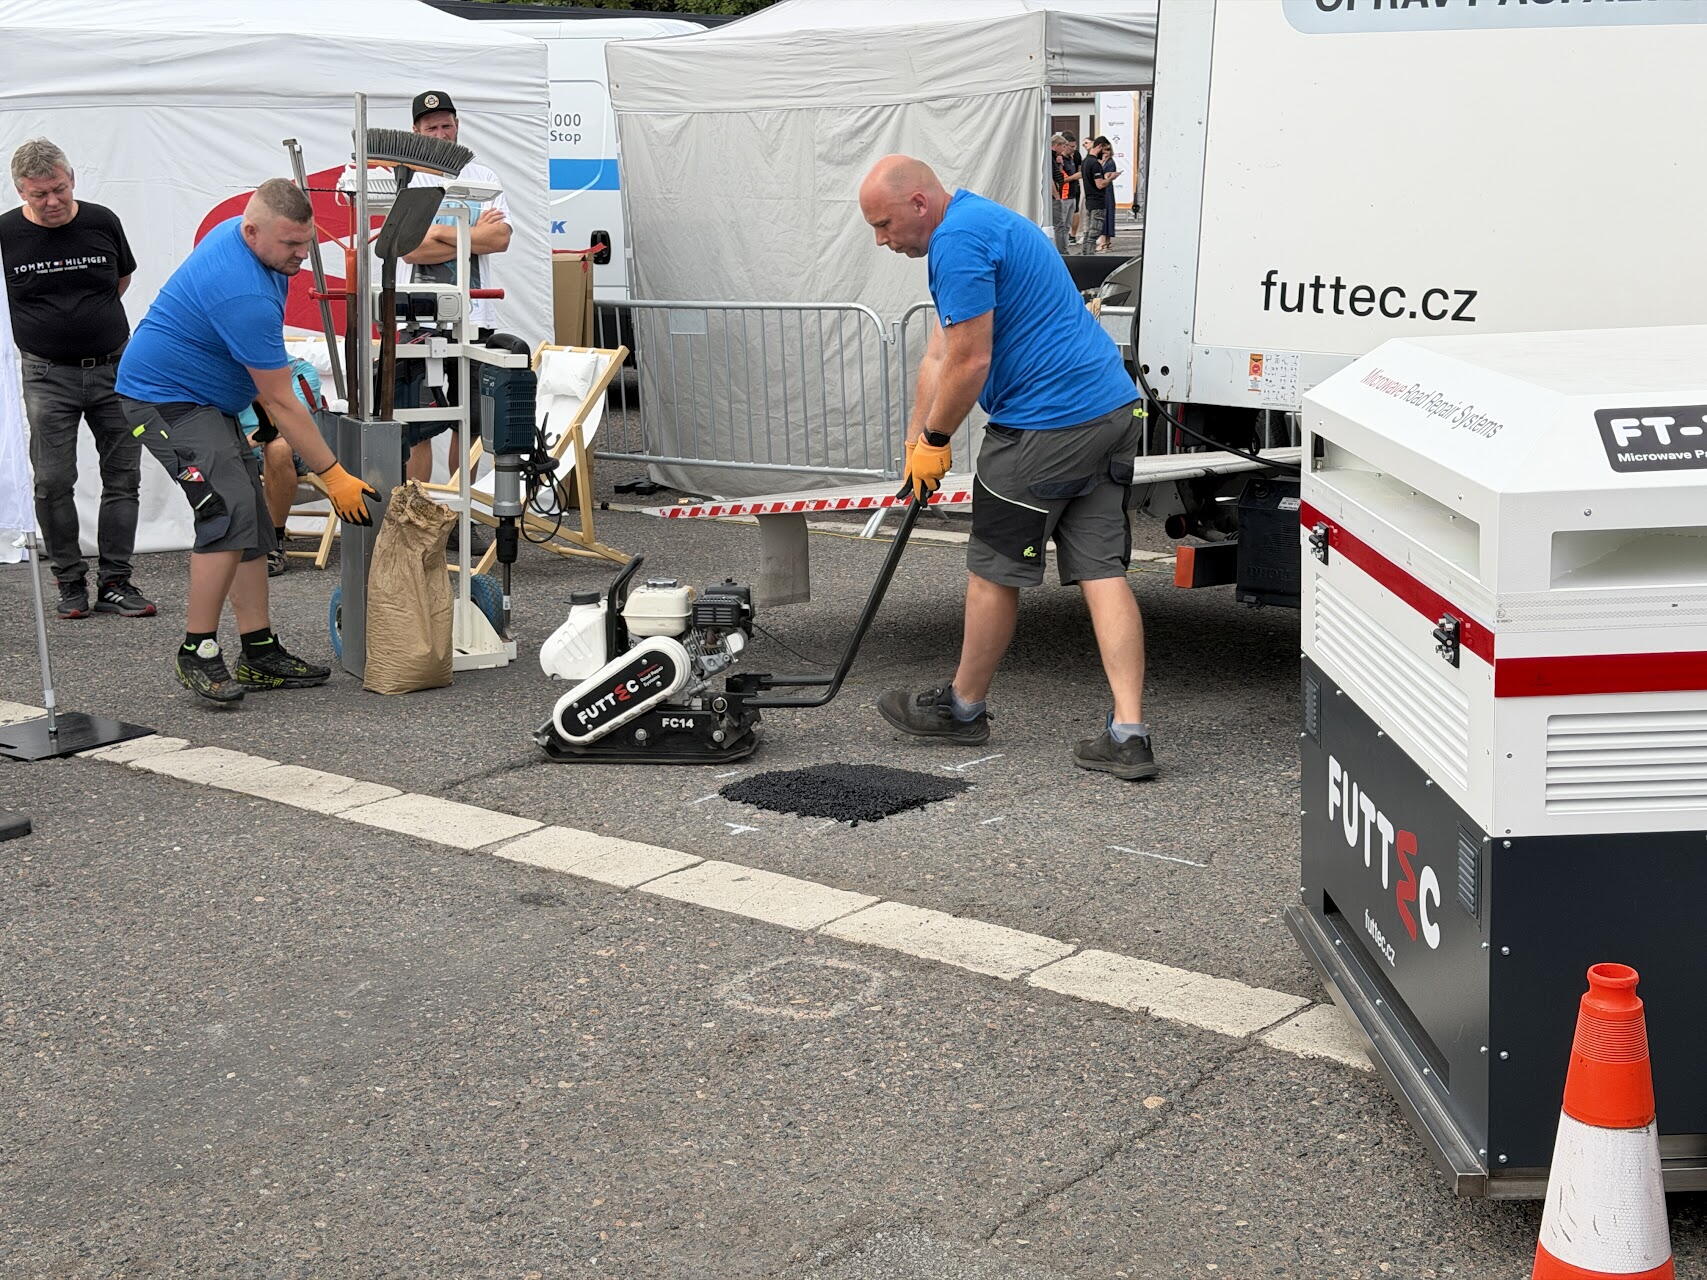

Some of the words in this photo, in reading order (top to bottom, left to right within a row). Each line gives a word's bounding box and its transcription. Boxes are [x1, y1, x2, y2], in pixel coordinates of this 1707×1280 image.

[550, 130, 581, 144] Stop
[550, 220, 567, 233] K
[14, 261, 51, 274] TOMMY
[65, 256, 107, 266] HILFIGER
[1261, 269, 1478, 322] futtec.cz
[1360, 368, 1408, 397] Microwave
[1400, 383, 1436, 409] Road
[1425, 392, 1463, 418] Repair
[1452, 405, 1503, 438] Systems
[1610, 415, 1707, 447] FT-
[1617, 452, 1692, 462] Microwave
[577, 680, 639, 725] FUTTEC
[661, 718, 694, 728] FC14
[1328, 755, 1440, 949] FUTTEC
[1364, 908, 1395, 967] futtec.cz
